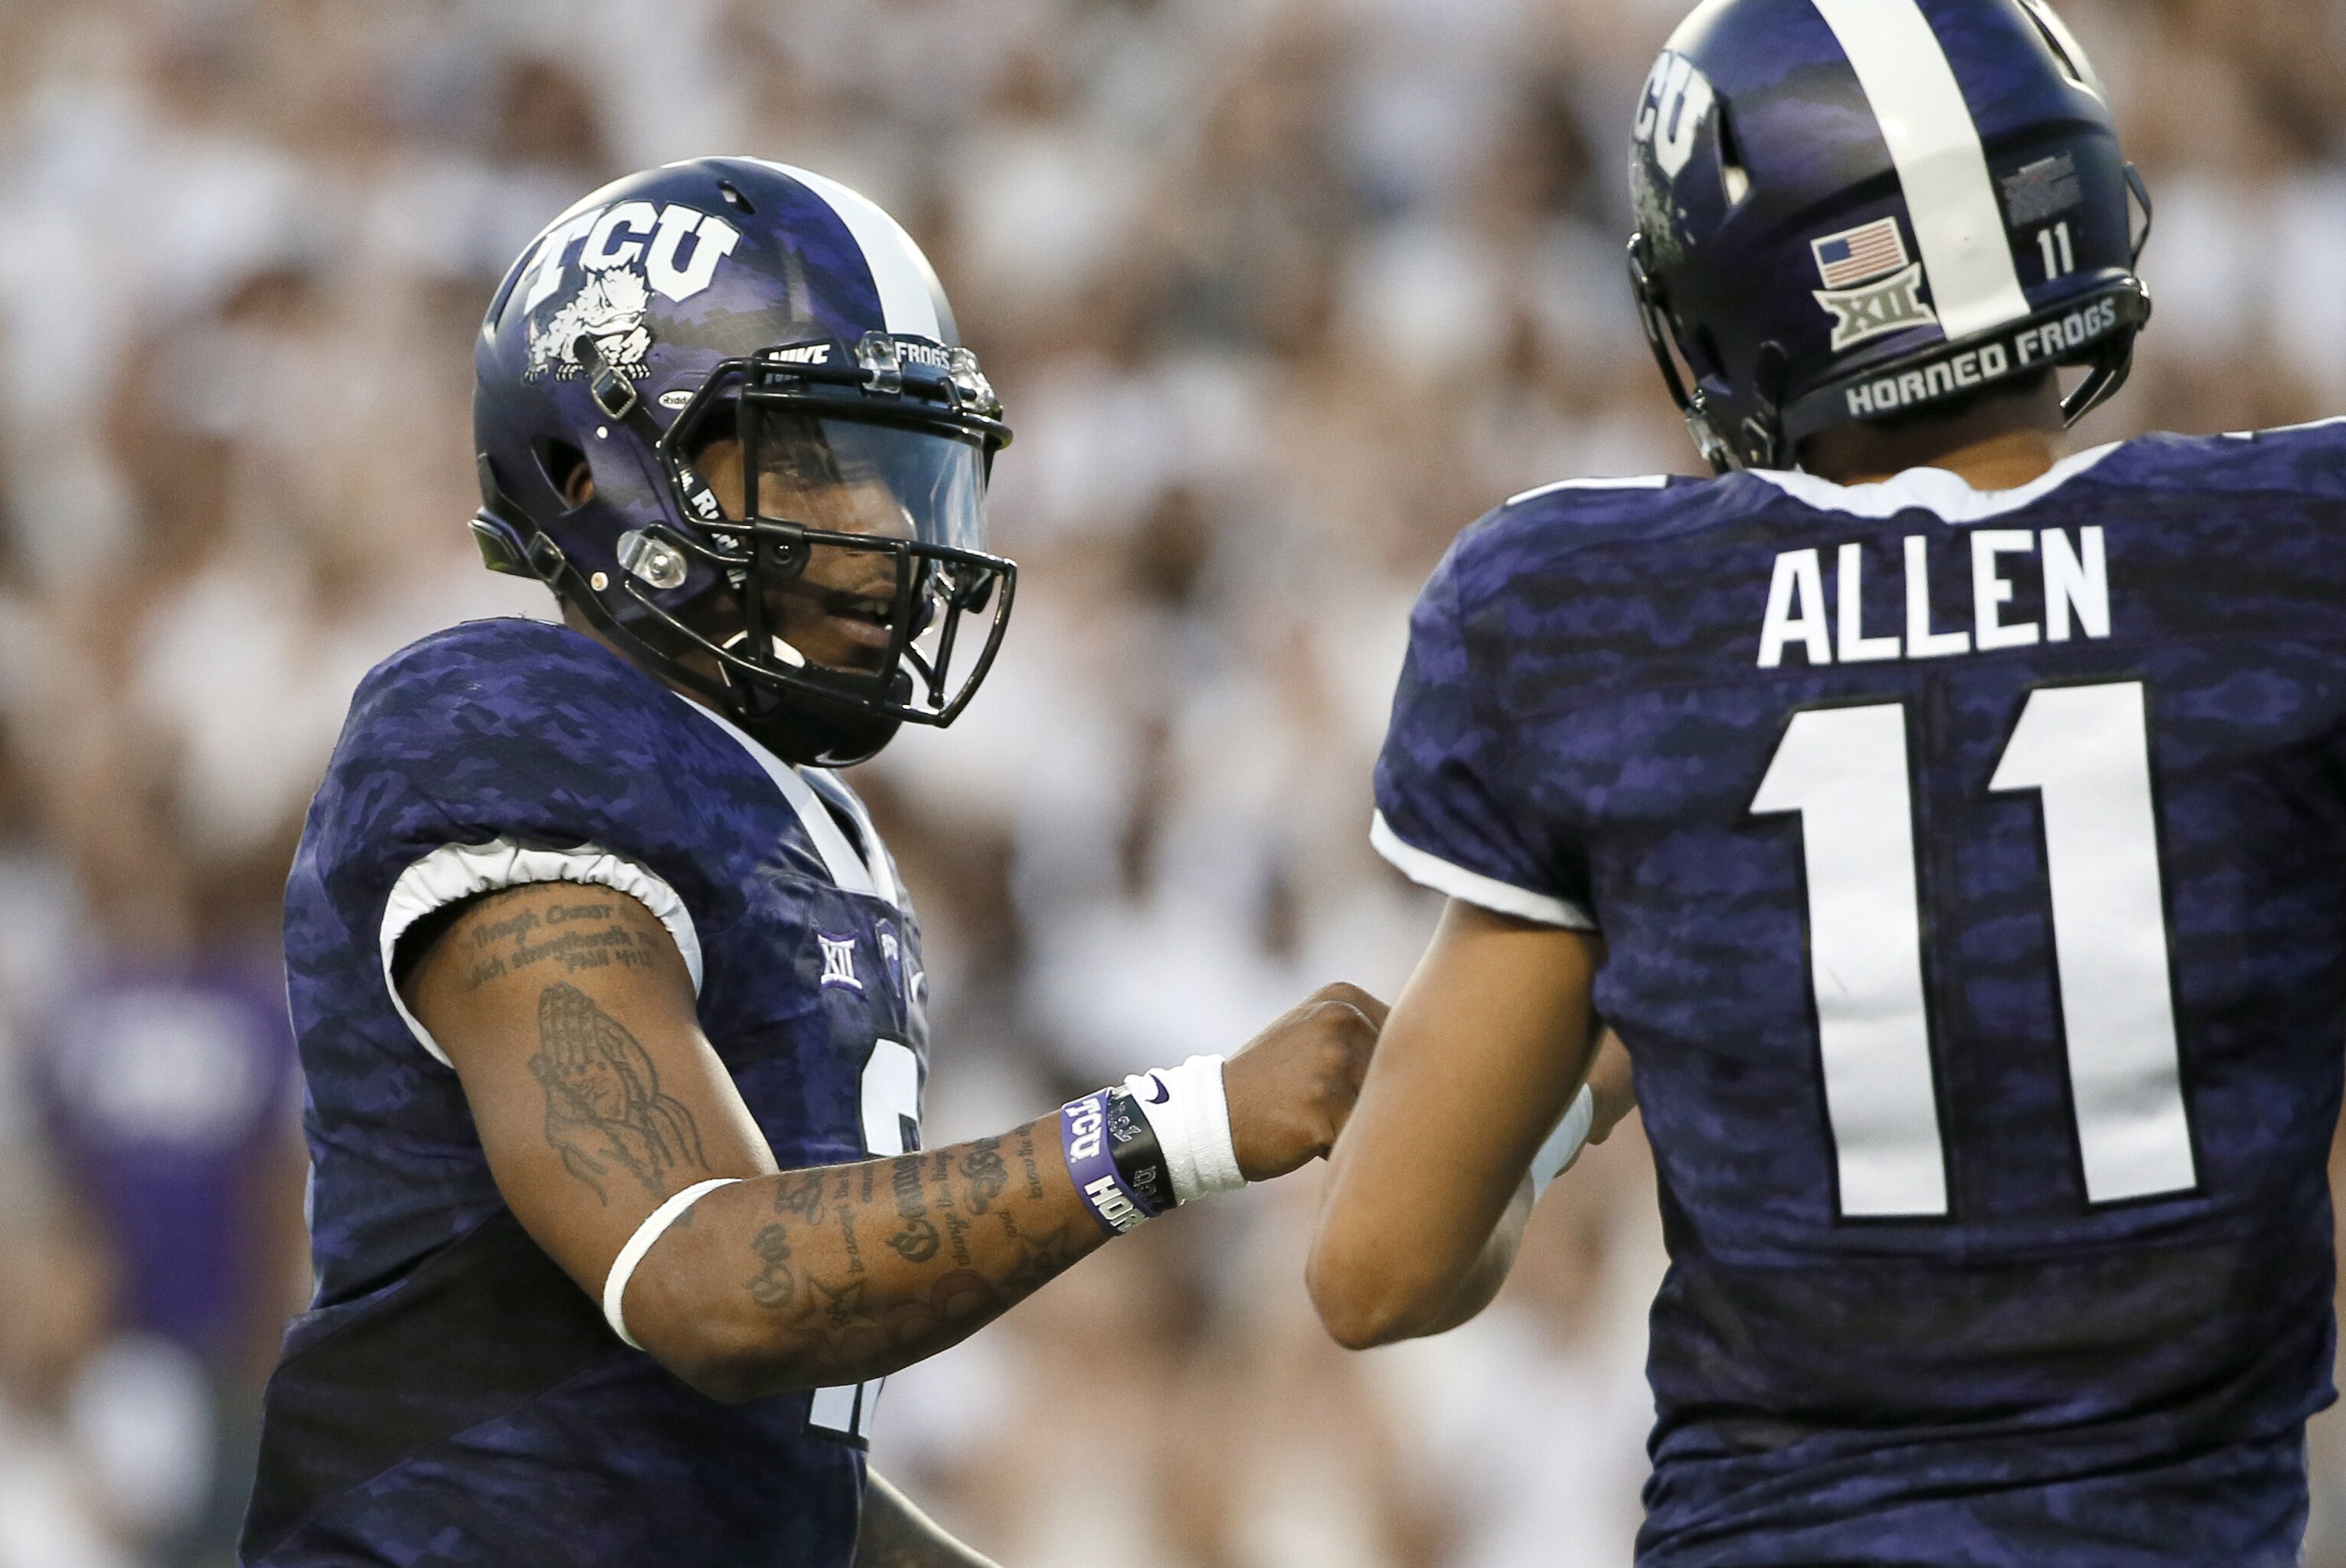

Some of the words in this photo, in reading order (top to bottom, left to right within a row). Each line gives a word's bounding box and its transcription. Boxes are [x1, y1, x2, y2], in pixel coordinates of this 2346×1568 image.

[1633, 51, 1715, 178] CU
[524, 201, 740, 315] TCU
[2036, 220, 2075, 281] 11
[894, 341, 951, 371] FROGS
[1845, 342, 2009, 419] HORNED
[2014, 297, 2116, 366] FROGS
[1756, 525, 2111, 670] ALLEN
[817, 933, 863, 990] XII
[1748, 680, 2198, 1217] 11
[1084, 1175, 1150, 1233] HOR
